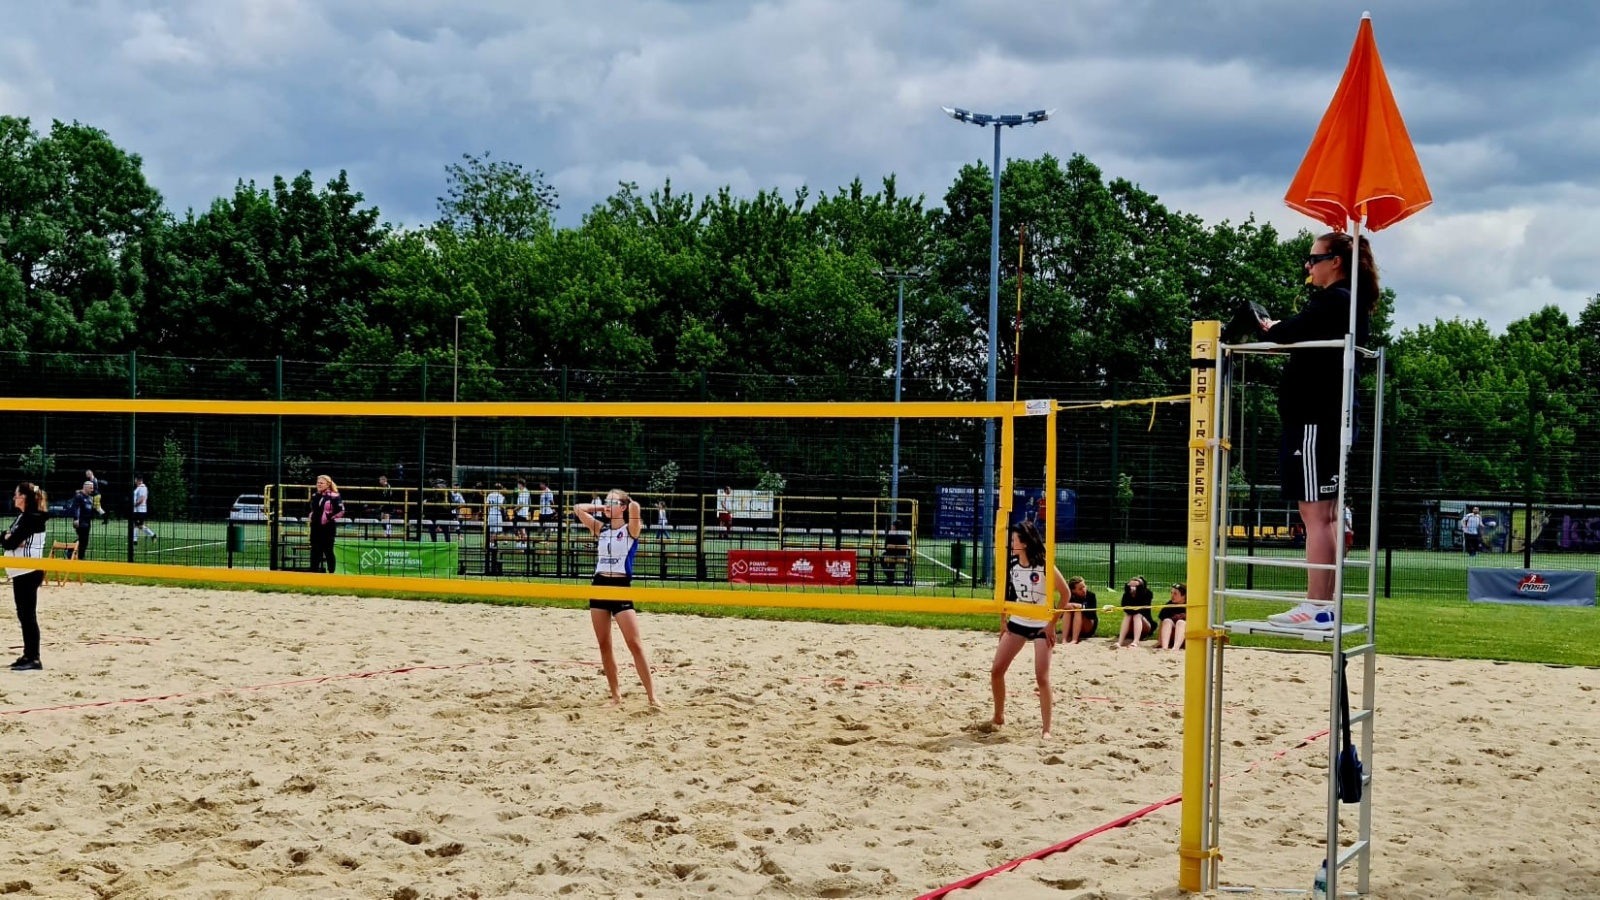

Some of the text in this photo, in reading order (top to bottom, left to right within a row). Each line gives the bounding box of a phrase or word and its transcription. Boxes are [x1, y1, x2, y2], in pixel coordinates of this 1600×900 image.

[1196, 363, 1207, 404] PORT
[1195, 420, 1206, 496] TRNSFER
[1020, 583, 1028, 598] 2
